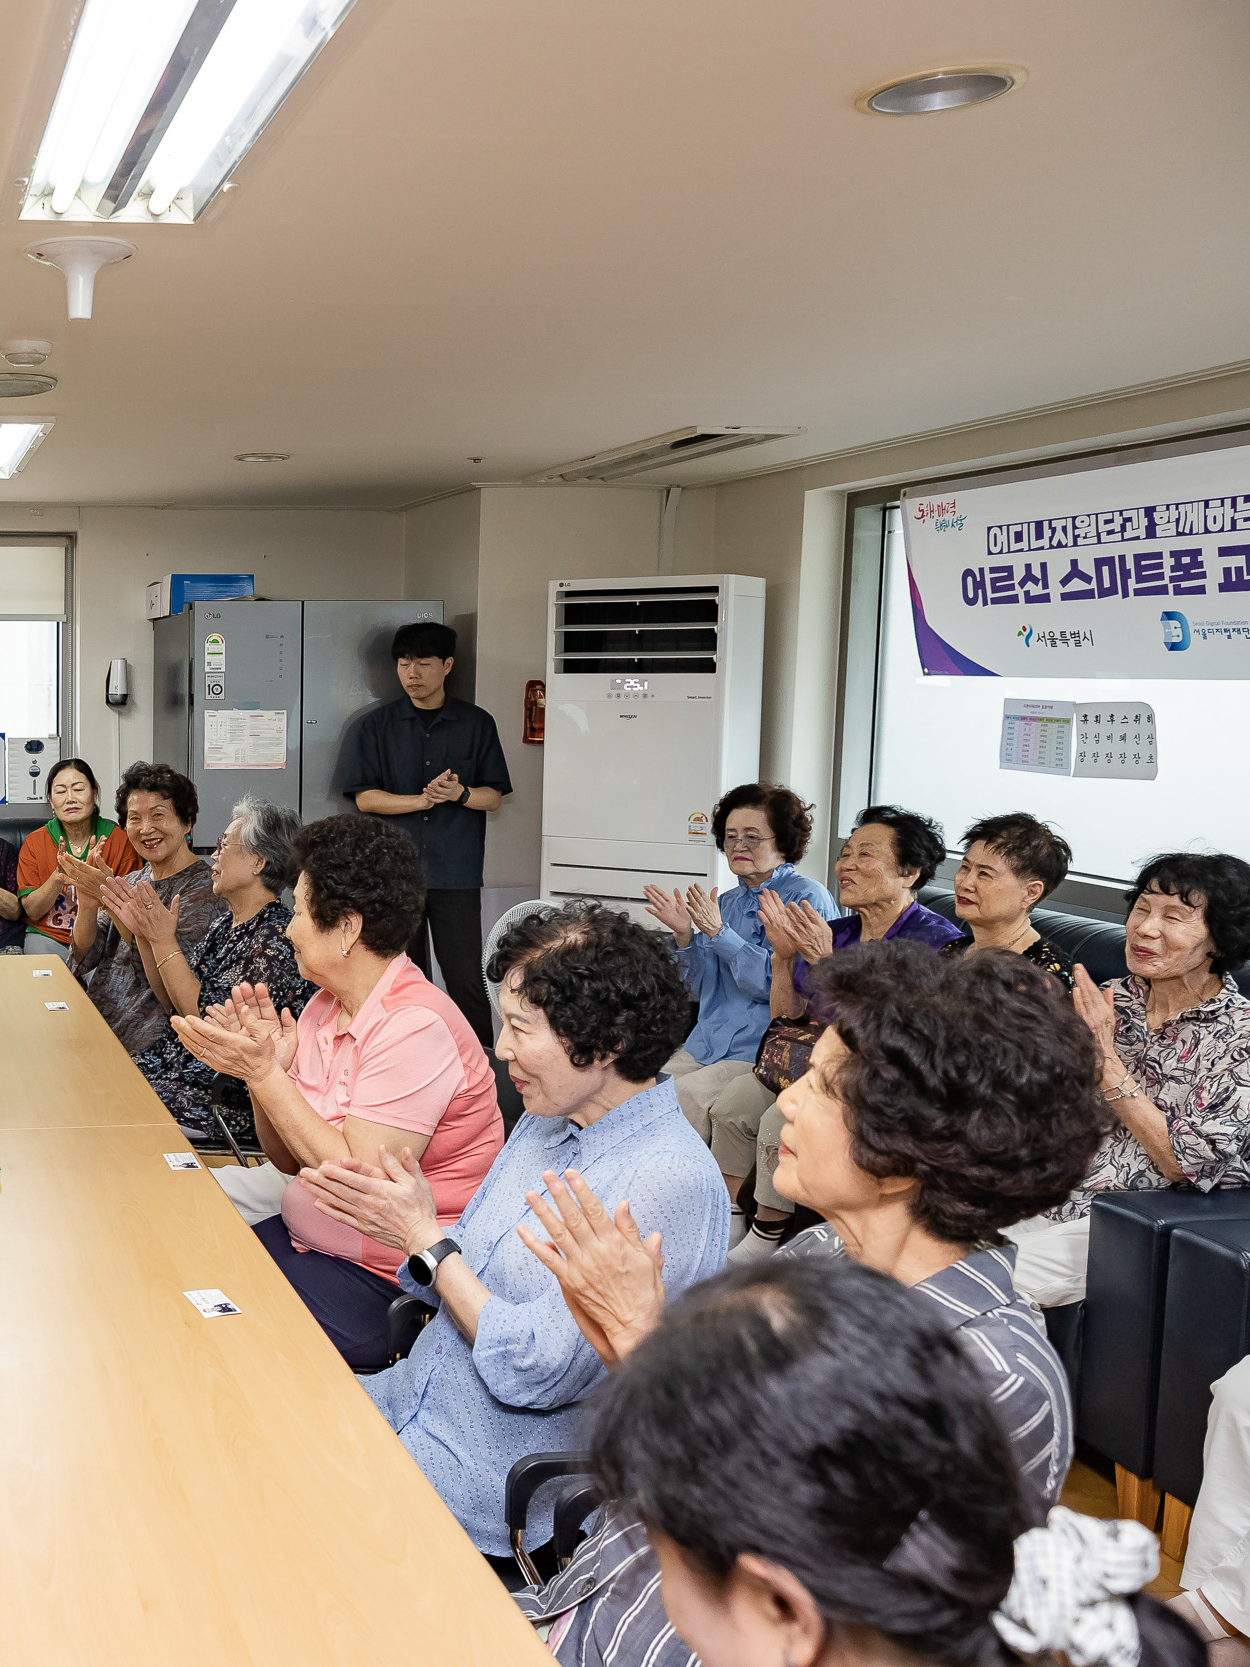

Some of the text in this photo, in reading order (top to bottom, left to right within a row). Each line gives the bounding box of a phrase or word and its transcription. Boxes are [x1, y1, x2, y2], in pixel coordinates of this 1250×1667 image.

[951, 515, 967, 531] 서울
[989, 508, 1148, 554] 어디나지원단과
[961, 562, 1051, 607] 어르신
[1059, 548, 1207, 602] 스마트폰
[1036, 630, 1094, 648] 서울특별시
[1193, 628, 1250, 640] 서울디지털재단
